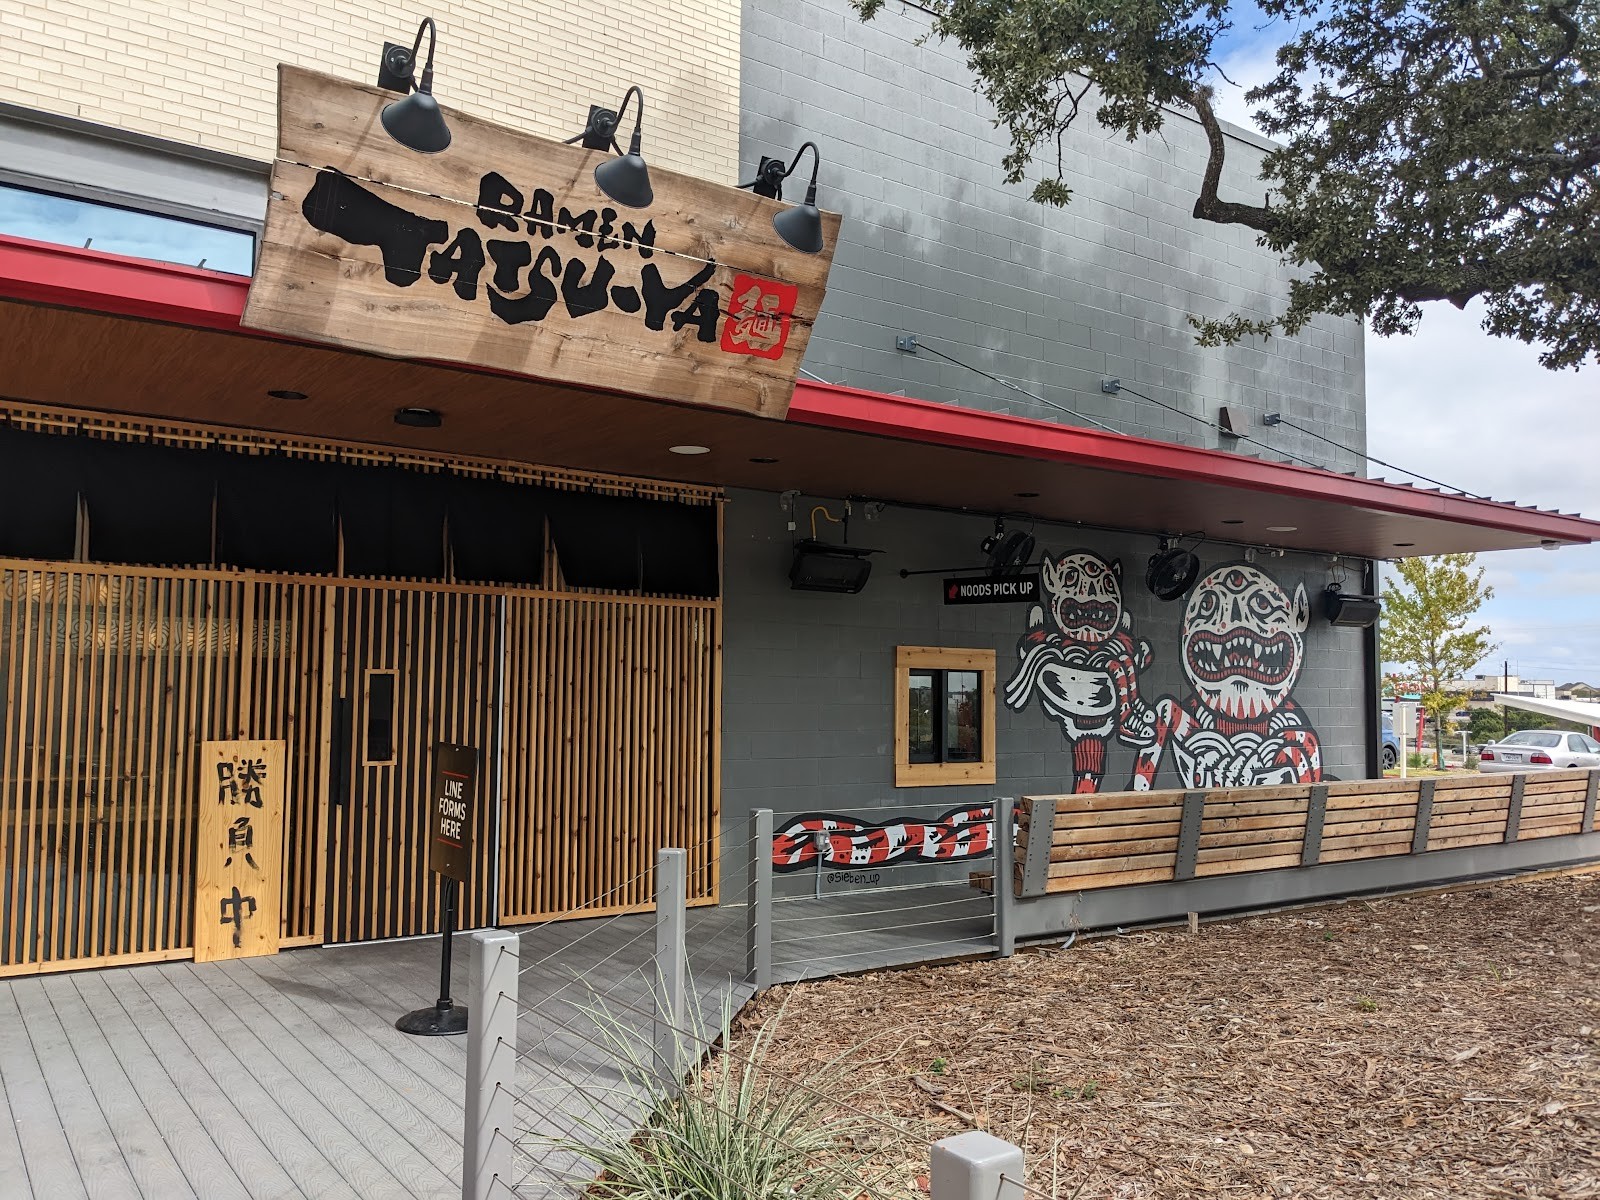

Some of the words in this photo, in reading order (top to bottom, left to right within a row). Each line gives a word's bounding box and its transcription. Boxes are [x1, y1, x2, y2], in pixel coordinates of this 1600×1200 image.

[476, 171, 656, 259] RAMEN
[302, 166, 719, 343] TATSU-YA
[960, 584, 992, 597] NOODS
[993, 582, 1017, 596] PICK
[1019, 581, 1034, 595] UP
[444, 779, 464, 800] LINE
[438, 797, 467, 821] FORMS
[440, 817, 462, 840] HERE
